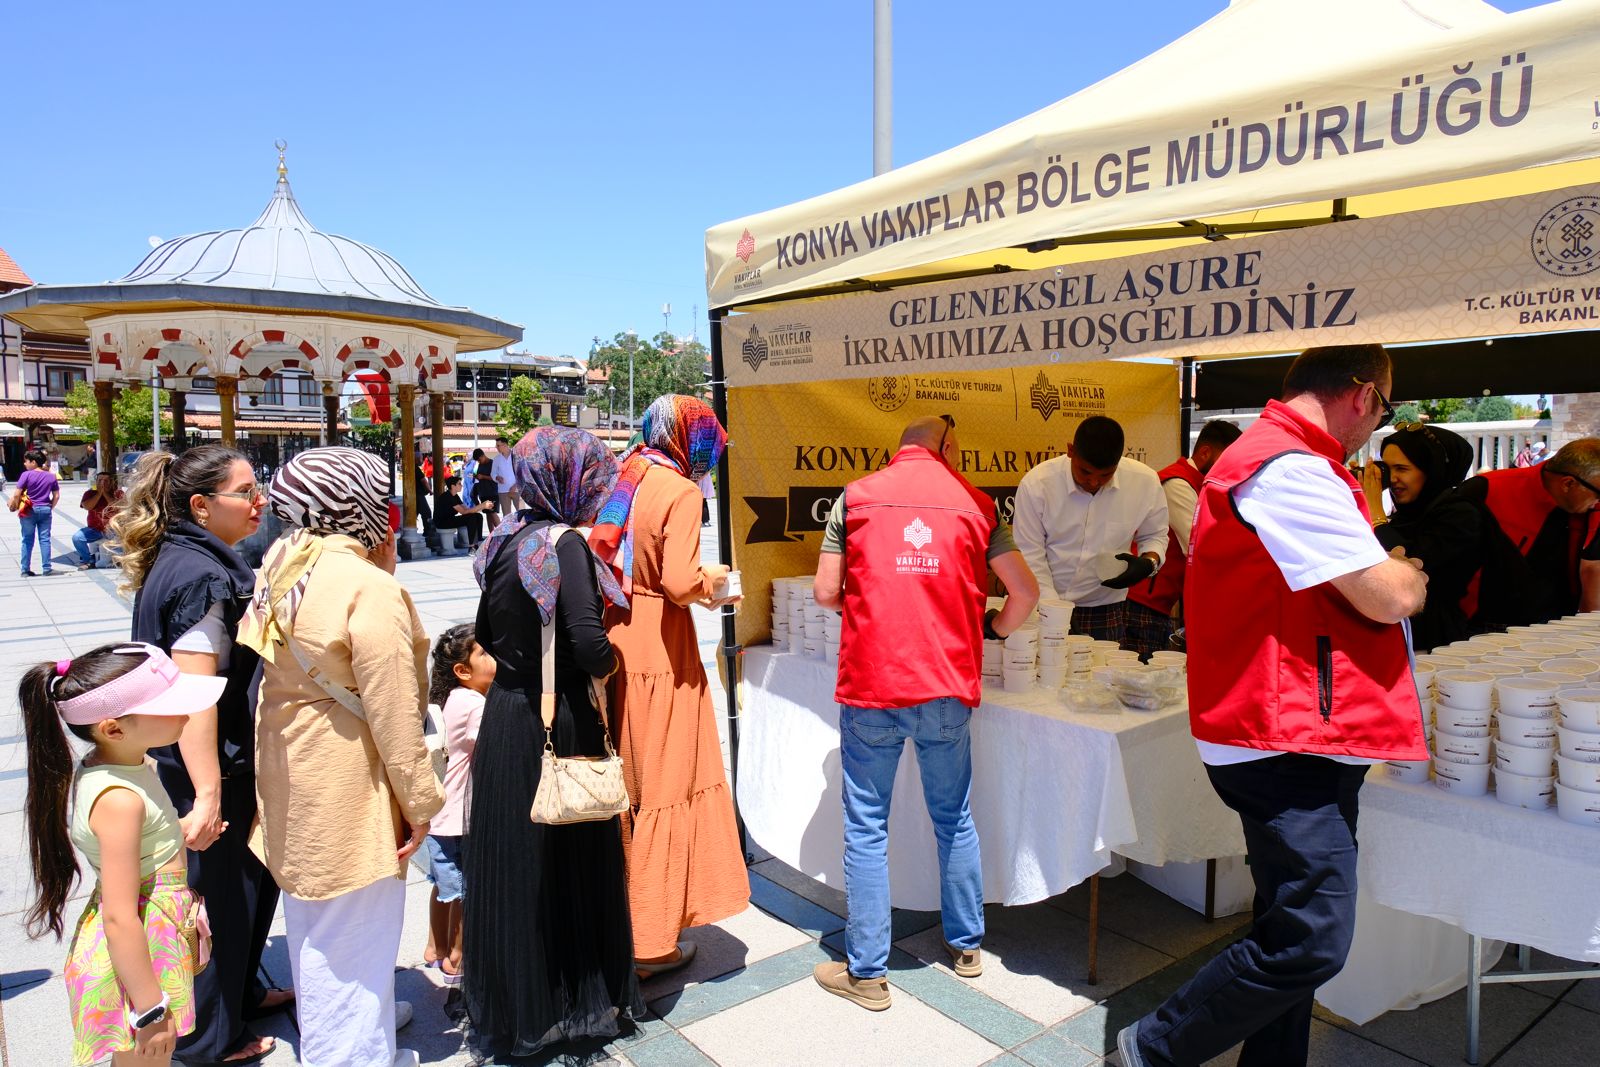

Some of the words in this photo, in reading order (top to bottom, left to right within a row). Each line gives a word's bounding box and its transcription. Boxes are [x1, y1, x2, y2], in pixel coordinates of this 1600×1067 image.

[776, 219, 858, 270] KONYA
[861, 184, 1006, 250] VAKIFLAR
[1017, 144, 1151, 215] BÖLGE
[1165, 52, 1535, 188] MÜDÜRLÜĞÜ
[734, 269, 761, 284] VAKIFLAR
[889, 273, 1106, 327] GELENEKSEL
[1112, 250, 1262, 306] AŞURE
[1465, 292, 1495, 312] T.C.
[1500, 287, 1575, 309] KÜLTÜR
[843, 328, 1033, 367] İKRAMIMIZA
[1040, 282, 1358, 355] HOŞGELDİNİZ
[768, 330, 811, 347] VAKIFLAR
[914, 378, 929, 388] T.C.
[930, 378, 961, 390] KÜLTÜR
[962, 382, 973, 391] VE
[973, 381, 1003, 393] TURİZM
[1061, 385, 1105, 399] VAKIFLAR
[915, 390, 960, 401] BAKANLIĞI
[794, 445, 892, 472] KONYA
[896, 556, 940, 567] VAKIFLAR
